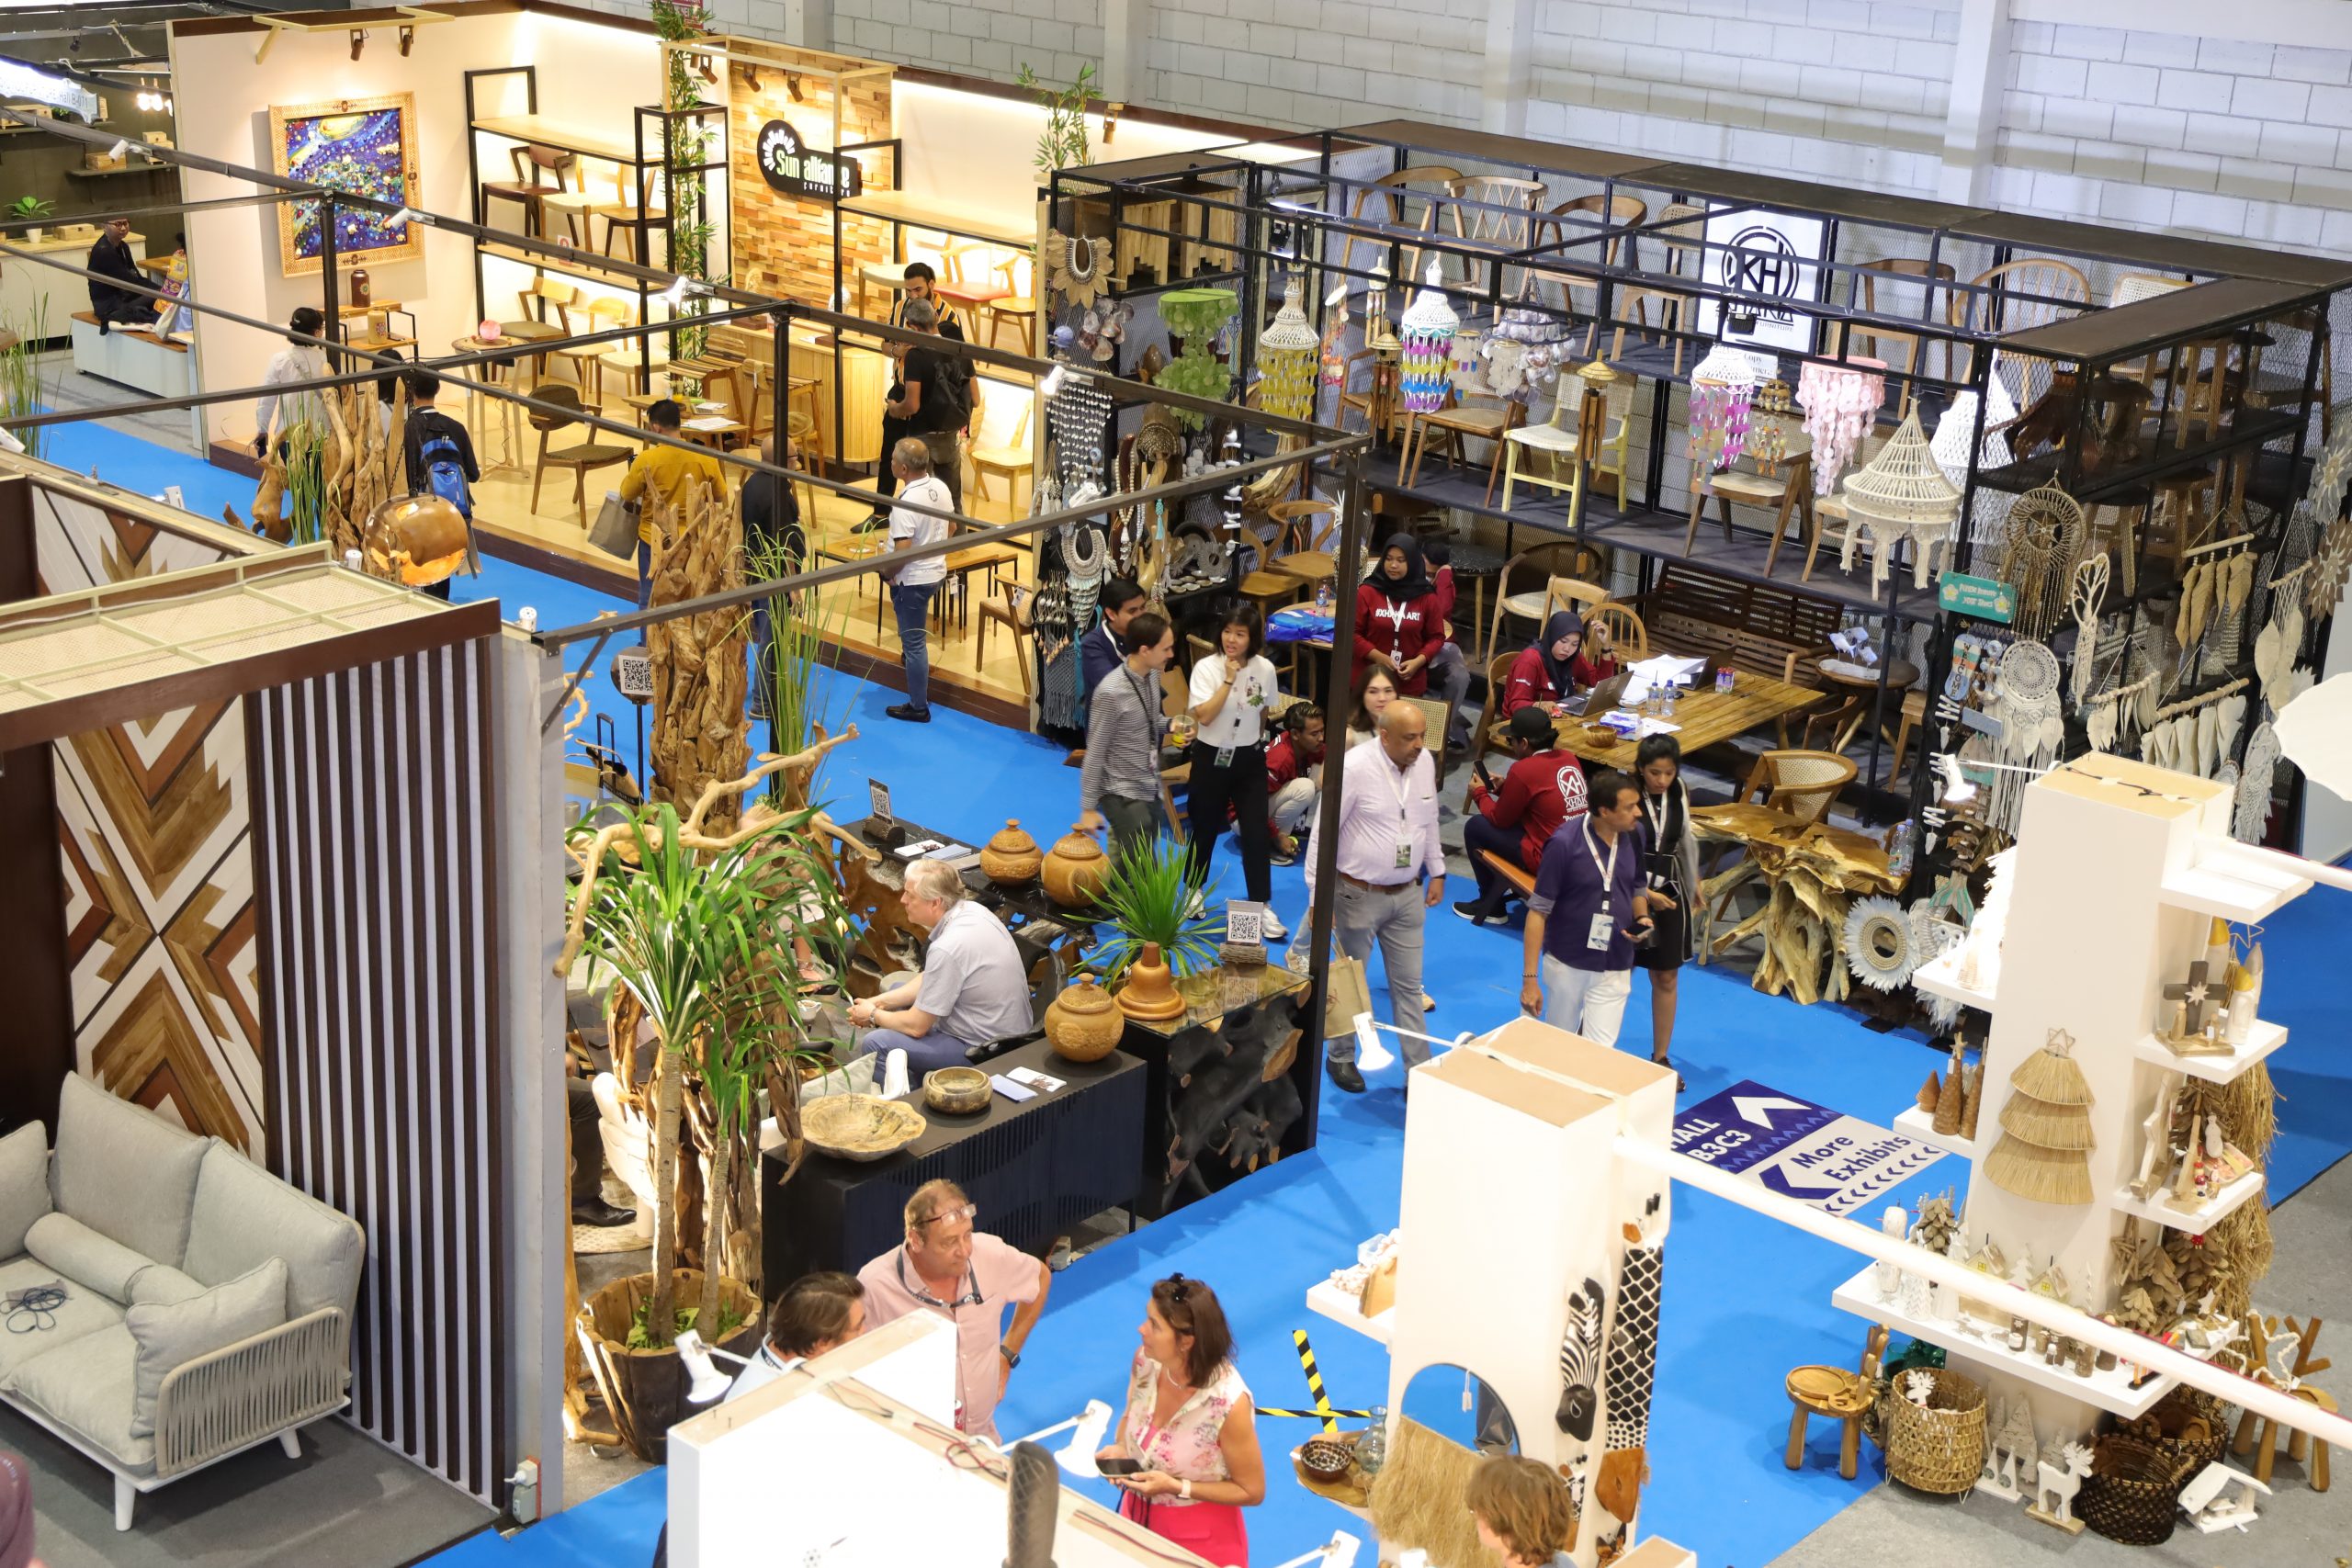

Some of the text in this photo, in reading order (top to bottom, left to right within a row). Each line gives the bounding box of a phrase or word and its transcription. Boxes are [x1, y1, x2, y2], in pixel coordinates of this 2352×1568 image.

[776, 150, 850, 188] Sun alliane
[804, 182, 851, 197] furnitre
[1407, 612, 1420, 621] ART
[1951, 643, 1971, 697] WELCOME
[1565, 795, 1589, 808] XHAK
[1687, 1130, 1751, 1162] B3C3
[1790, 1137, 1854, 1168] More
[1823, 1137, 1911, 1181] Exhibits
